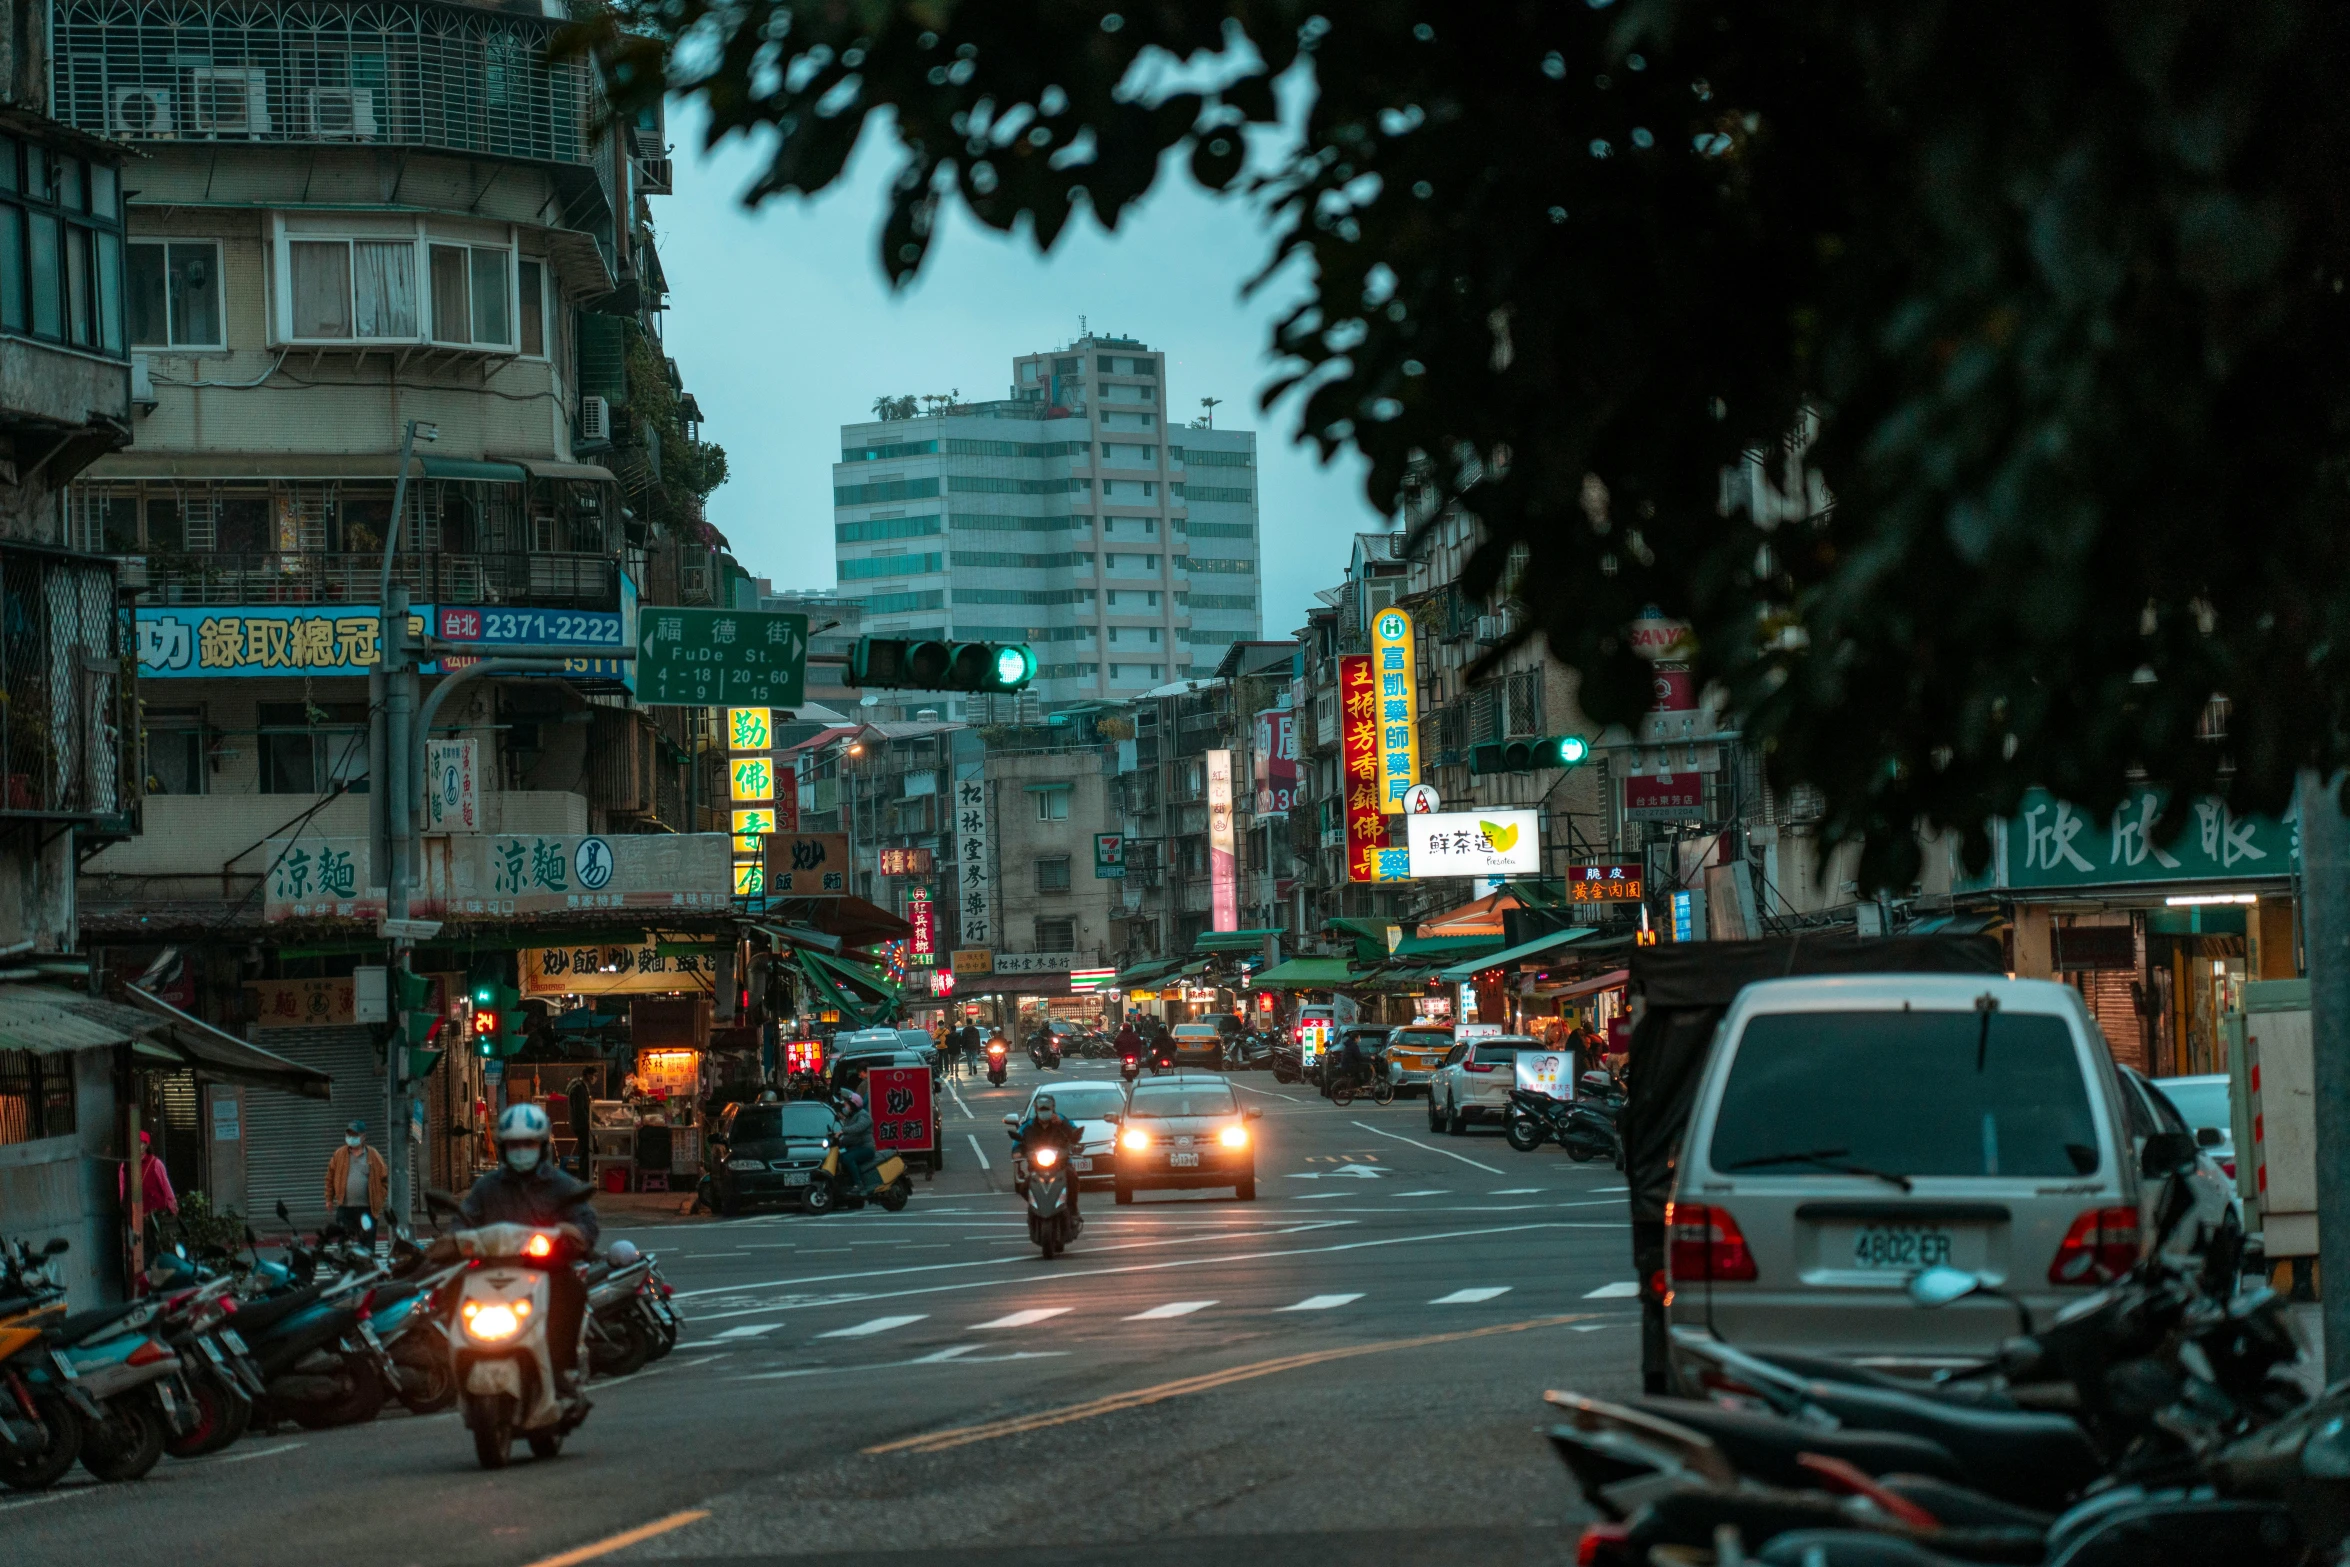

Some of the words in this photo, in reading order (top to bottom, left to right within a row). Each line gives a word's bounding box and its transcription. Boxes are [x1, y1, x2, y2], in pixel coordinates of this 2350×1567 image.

[445, 613, 477, 636] 台北
[485, 614, 620, 643] 2371-2222
[656, 617, 792, 645] 福德街
[672, 646, 724, 662] FuDe
[745, 649, 773, 663] St.
[693, 668, 712, 682] 18
[732, 669, 751, 684] 20
[770, 671, 789, 684] 60
[697, 686, 706, 699] 9
[750, 687, 769, 700] 15
[1381, 646, 1411, 803] 富凱藥師藥局
[1636, 795, 1694, 806] 台北東芳店
[1429, 830, 1494, 855] 鮮茶道
[2025, 794, 2299, 872] 欣欣眼
[495, 838, 569, 894] 涼麵
[792, 840, 825, 870] 炒
[959, 782, 988, 942] 松林堂參藥行
[277, 846, 357, 899] 涼麵
[1586, 867, 1625, 880] 脆皮
[671, 893, 726, 906] 美味可口
[911, 954, 934, 965] 24H
[476, 1012, 493, 1033] 24
[886, 1087, 914, 1115] 炒
